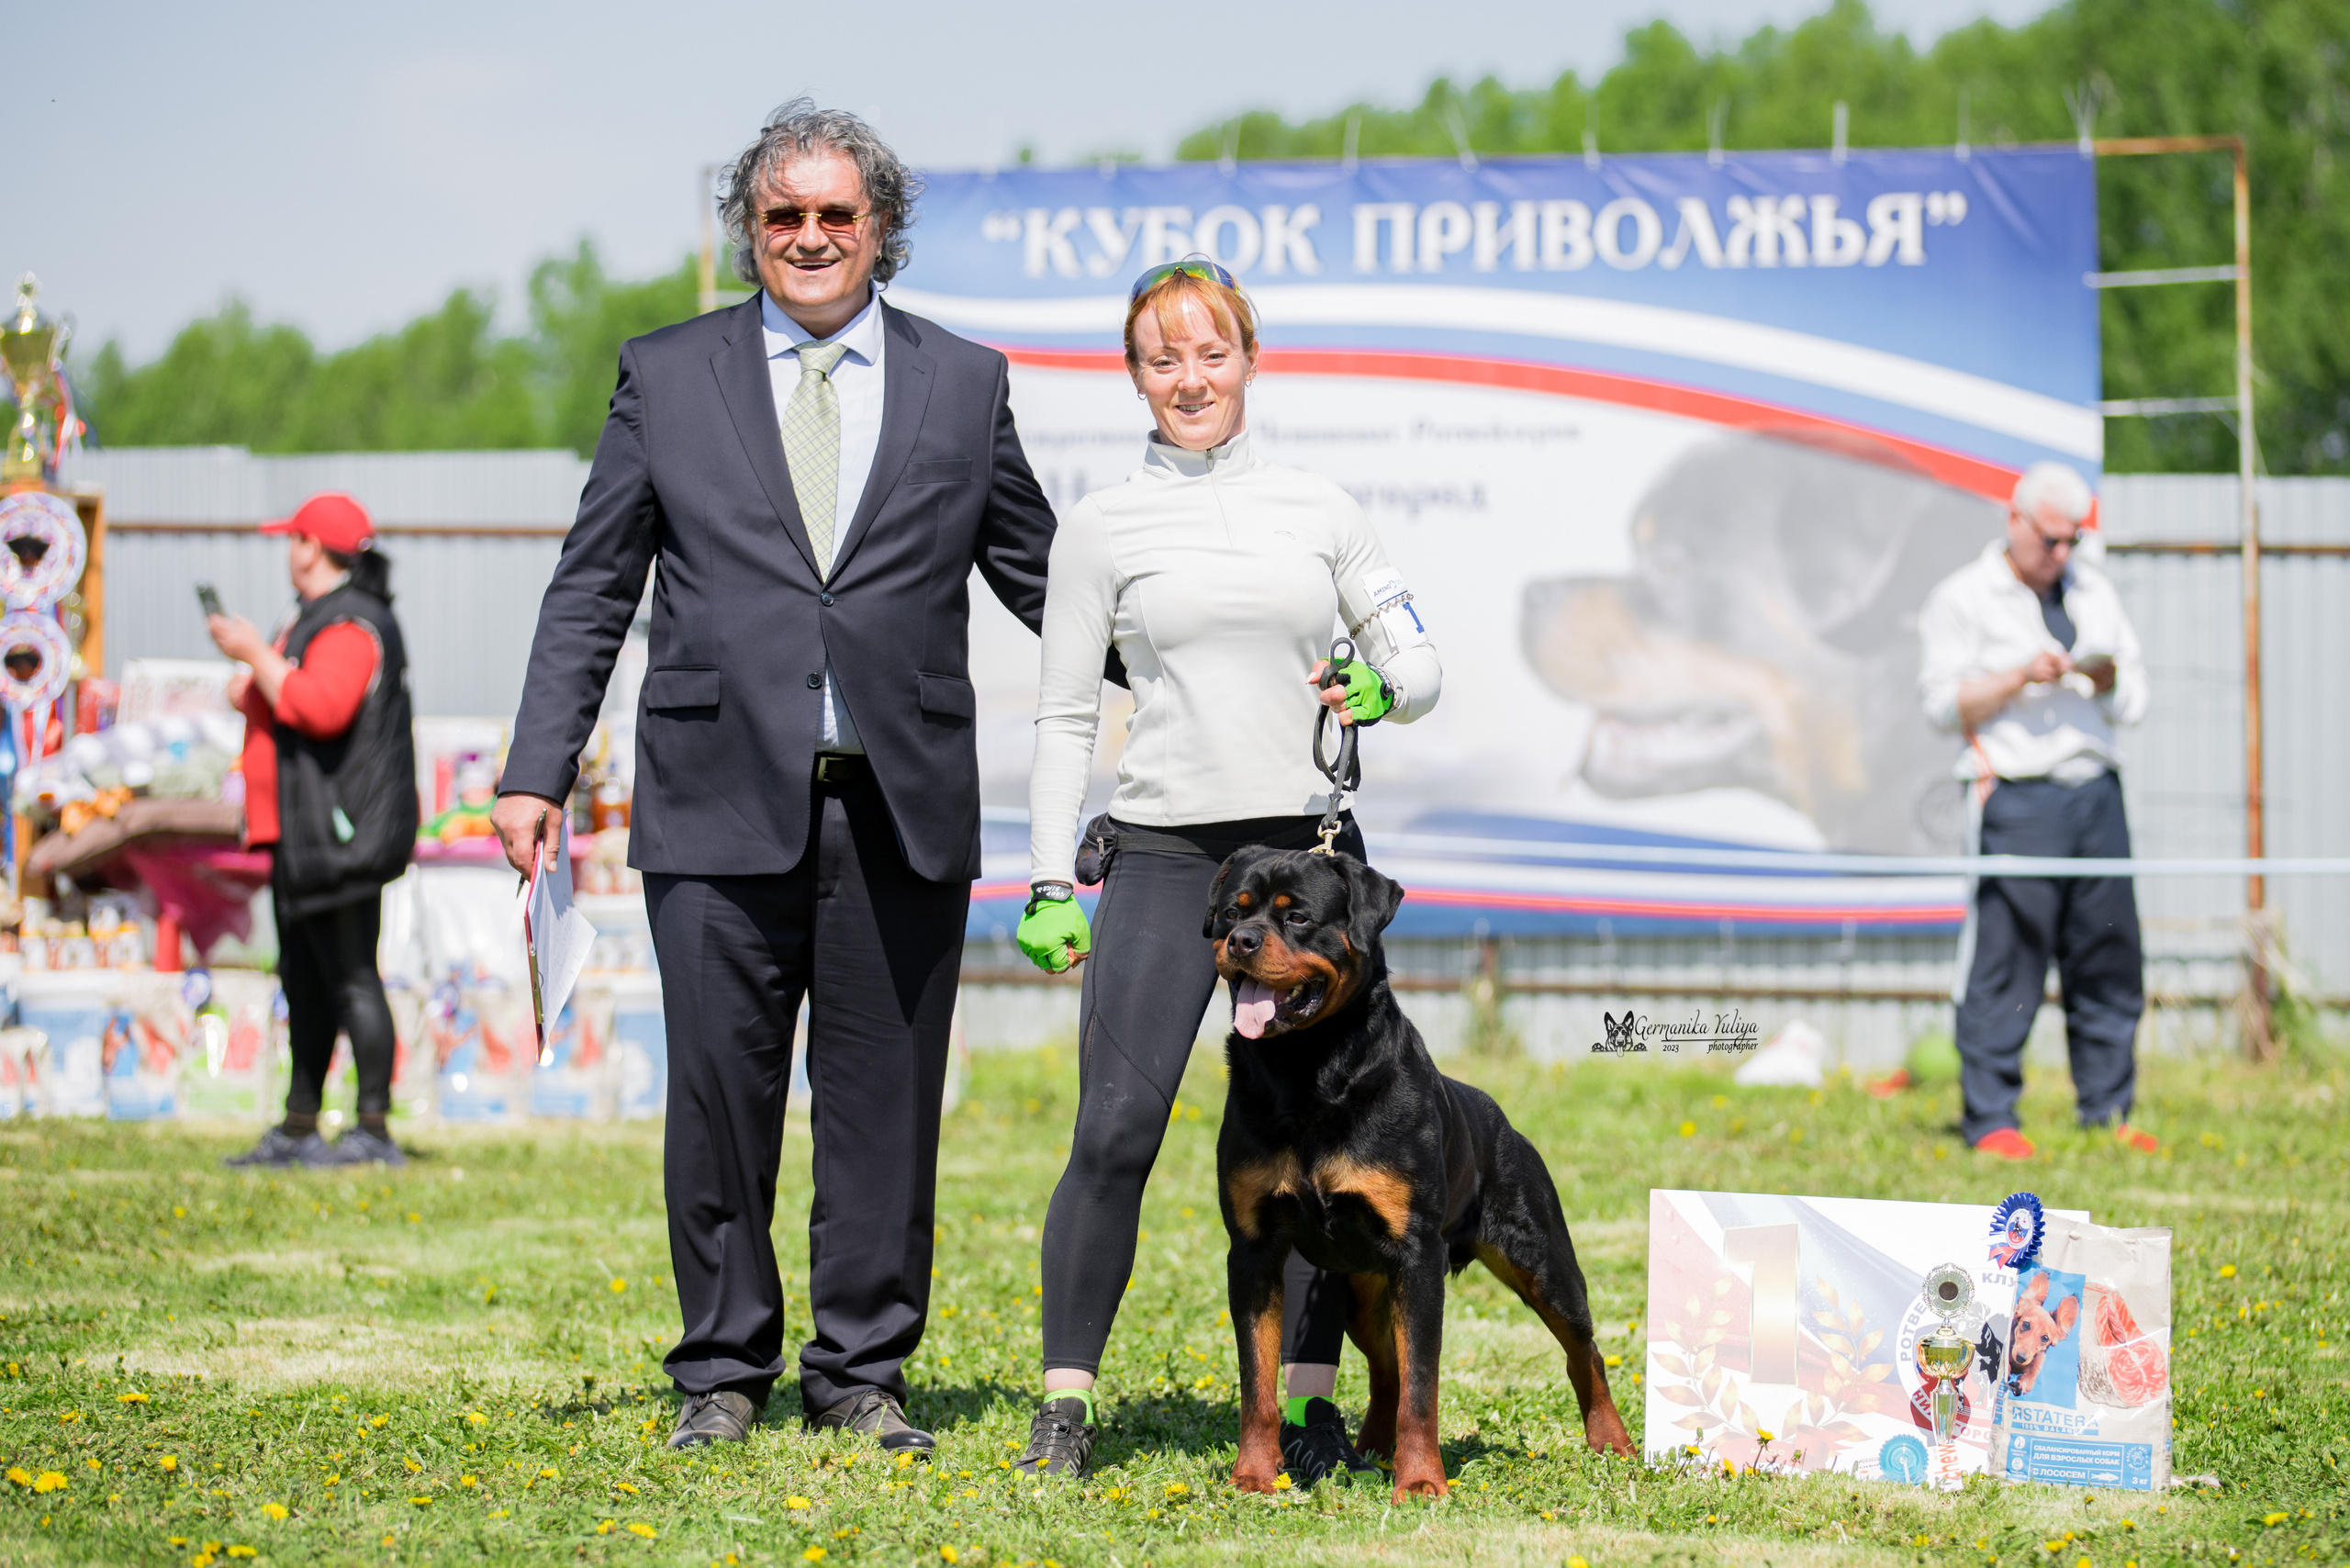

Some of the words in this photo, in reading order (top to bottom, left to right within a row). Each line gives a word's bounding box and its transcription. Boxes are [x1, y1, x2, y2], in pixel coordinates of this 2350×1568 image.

[1723, 1223, 1800, 1386] 1
[1900, 1301, 1928, 1362] РОТВЕ
[1982, 1272, 2017, 1287] КЛУ
[2023, 1407, 2099, 1428] STATERA
[2021, 1423, 2040, 1431] 100%
[2043, 1424, 2084, 1435] BALANC
[2033, 1444, 2101, 1456] СБАЛАНСИРОВАННЫЙ
[2032, 1452, 2050, 1461] ДЛЯ
[2051, 1453, 2094, 1464] ВЗРОСЛЫХ
[2094, 1457, 2120, 1466] СОБАК
[2032, 1467, 2039, 1476] С
[2040, 1468, 2086, 1479] ЛОСОСЕМ
[2132, 1476, 2139, 1485] 3
